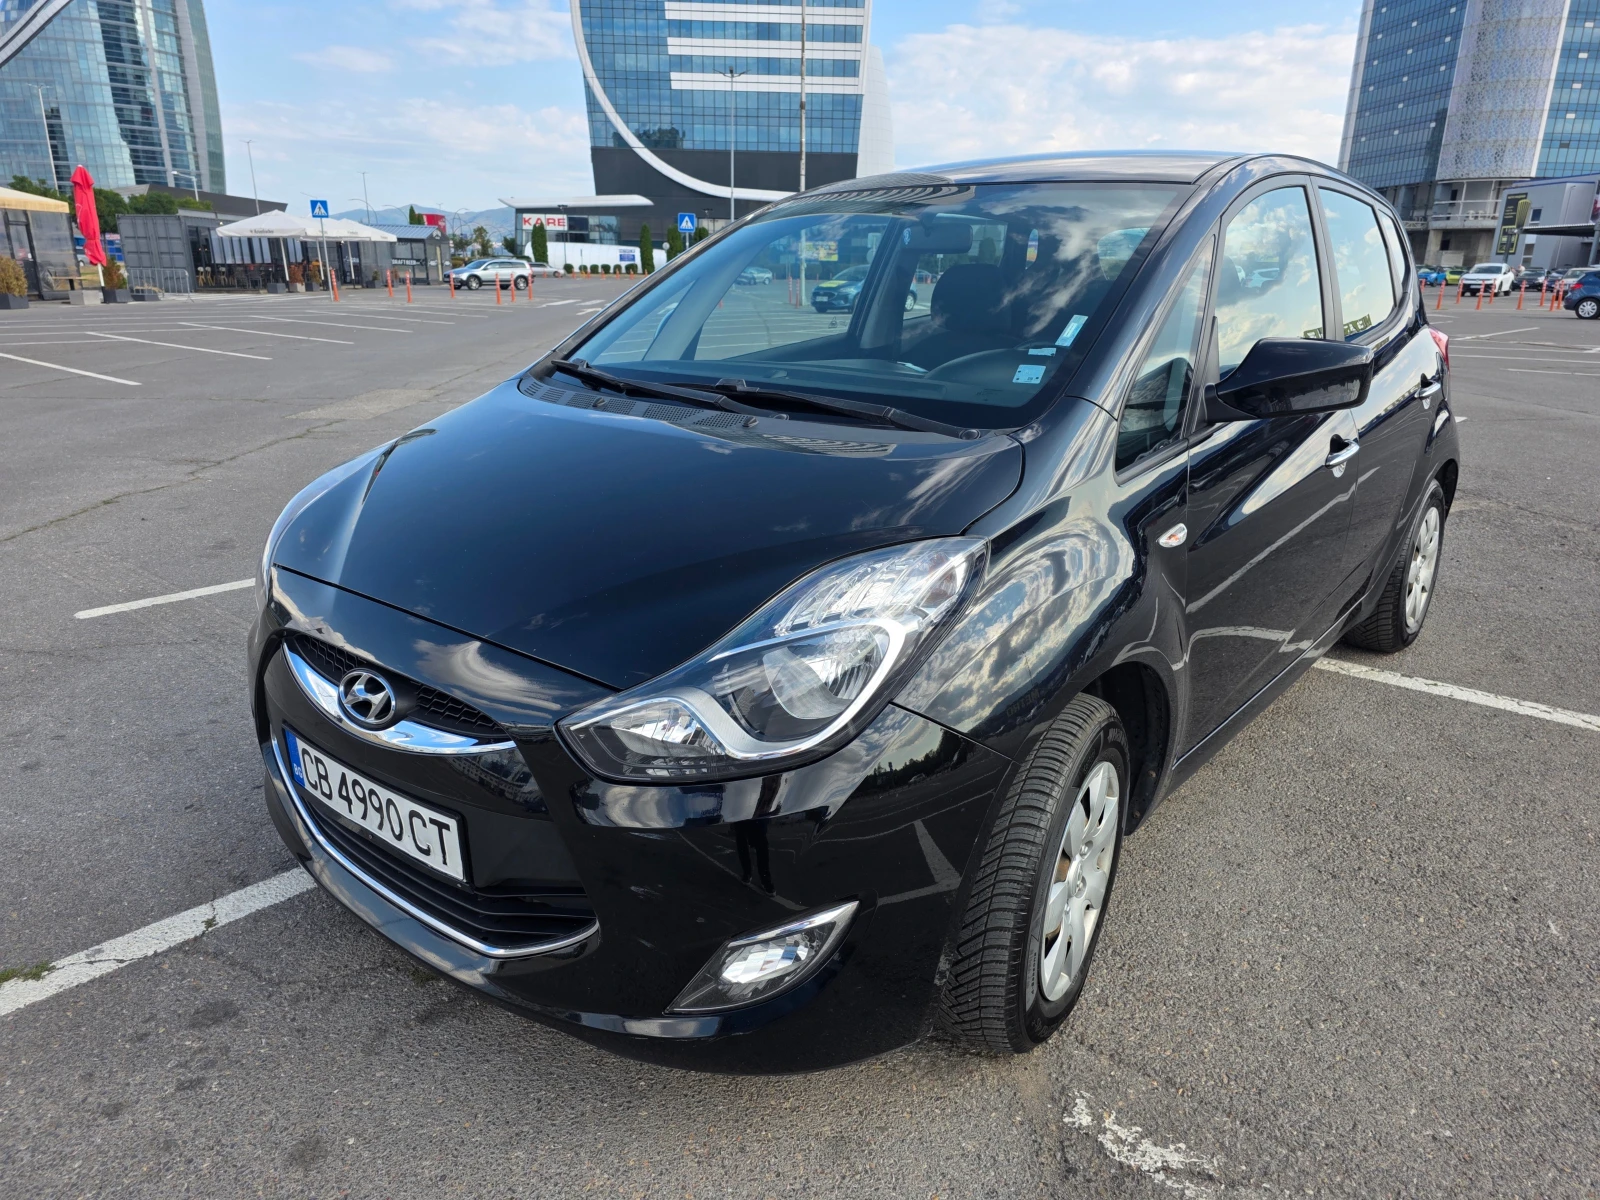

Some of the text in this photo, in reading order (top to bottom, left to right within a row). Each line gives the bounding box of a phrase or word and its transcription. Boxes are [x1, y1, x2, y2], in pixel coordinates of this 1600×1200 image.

[522, 217, 566, 226] KARE
[294, 763, 303, 778] BG
[301, 748, 451, 866] CB 4990 CT
